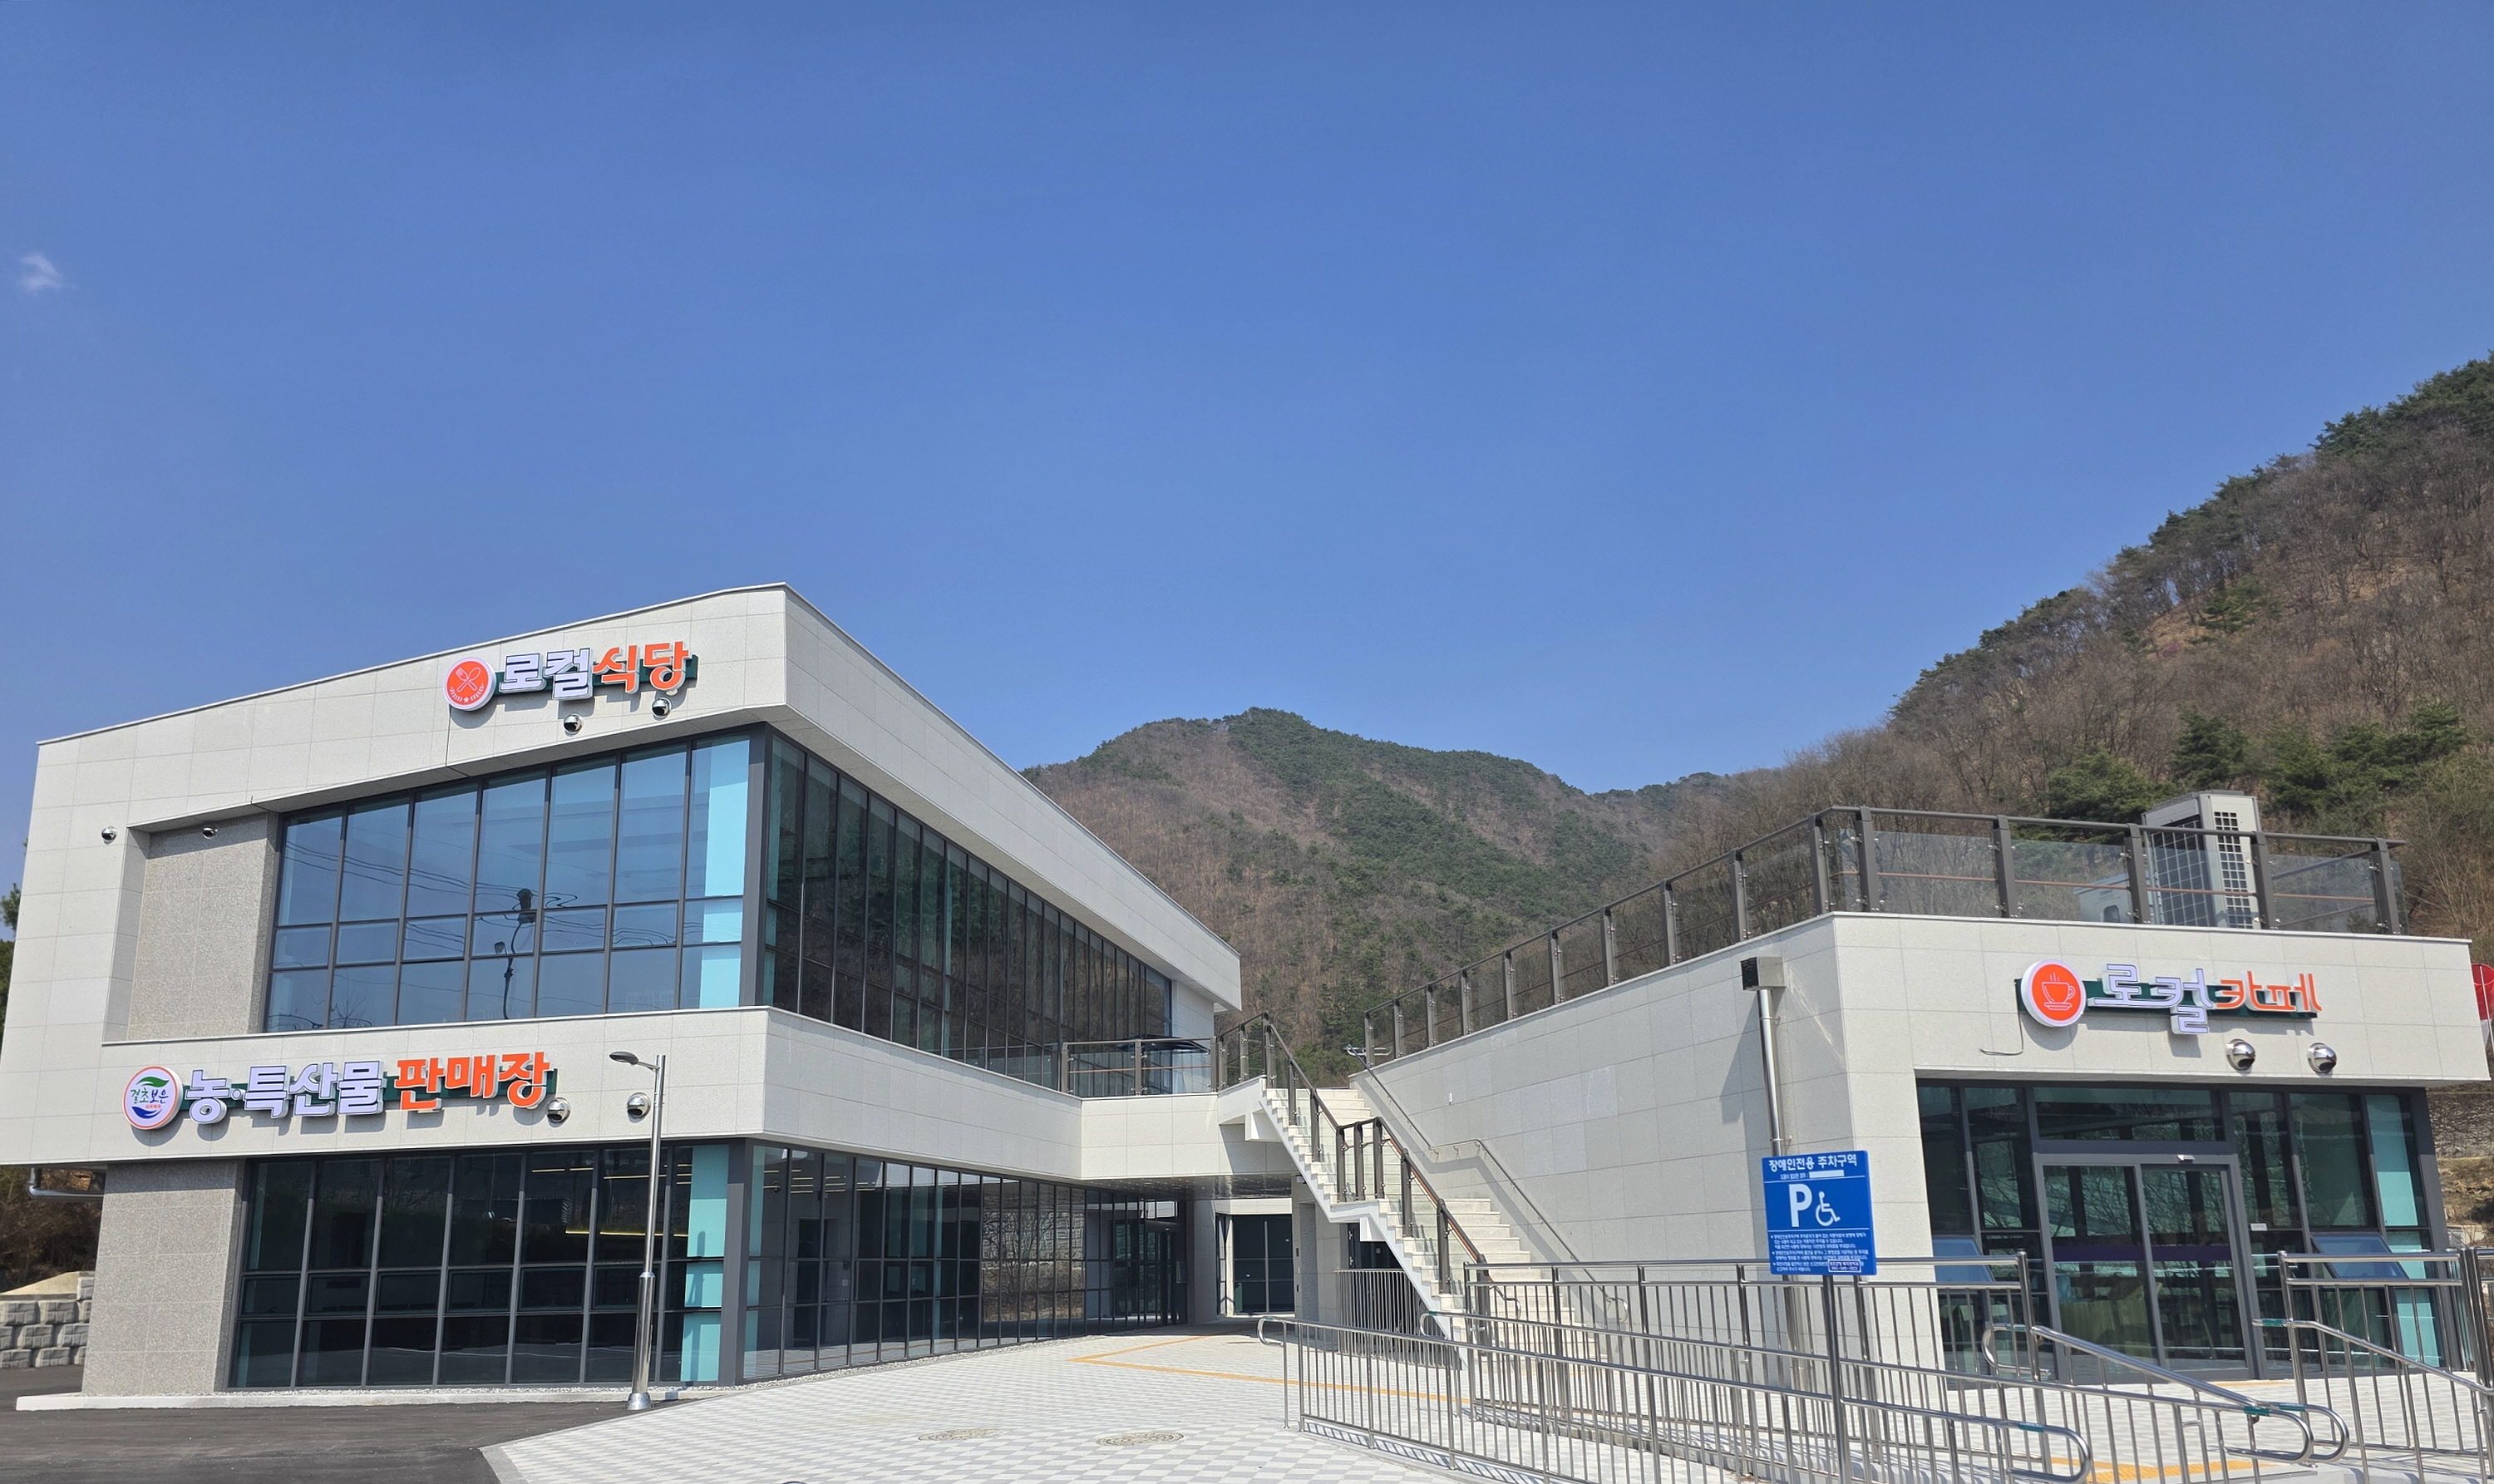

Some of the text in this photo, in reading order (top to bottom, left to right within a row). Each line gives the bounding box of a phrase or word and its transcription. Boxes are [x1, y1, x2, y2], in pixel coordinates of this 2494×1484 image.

[131, 1087, 169, 1104] 결초보은
[392, 1051, 551, 1112] 판매장
[1768, 1154, 1857, 1173] 장애인전용 주차구역
[1788, 1183, 1812, 1228] P
